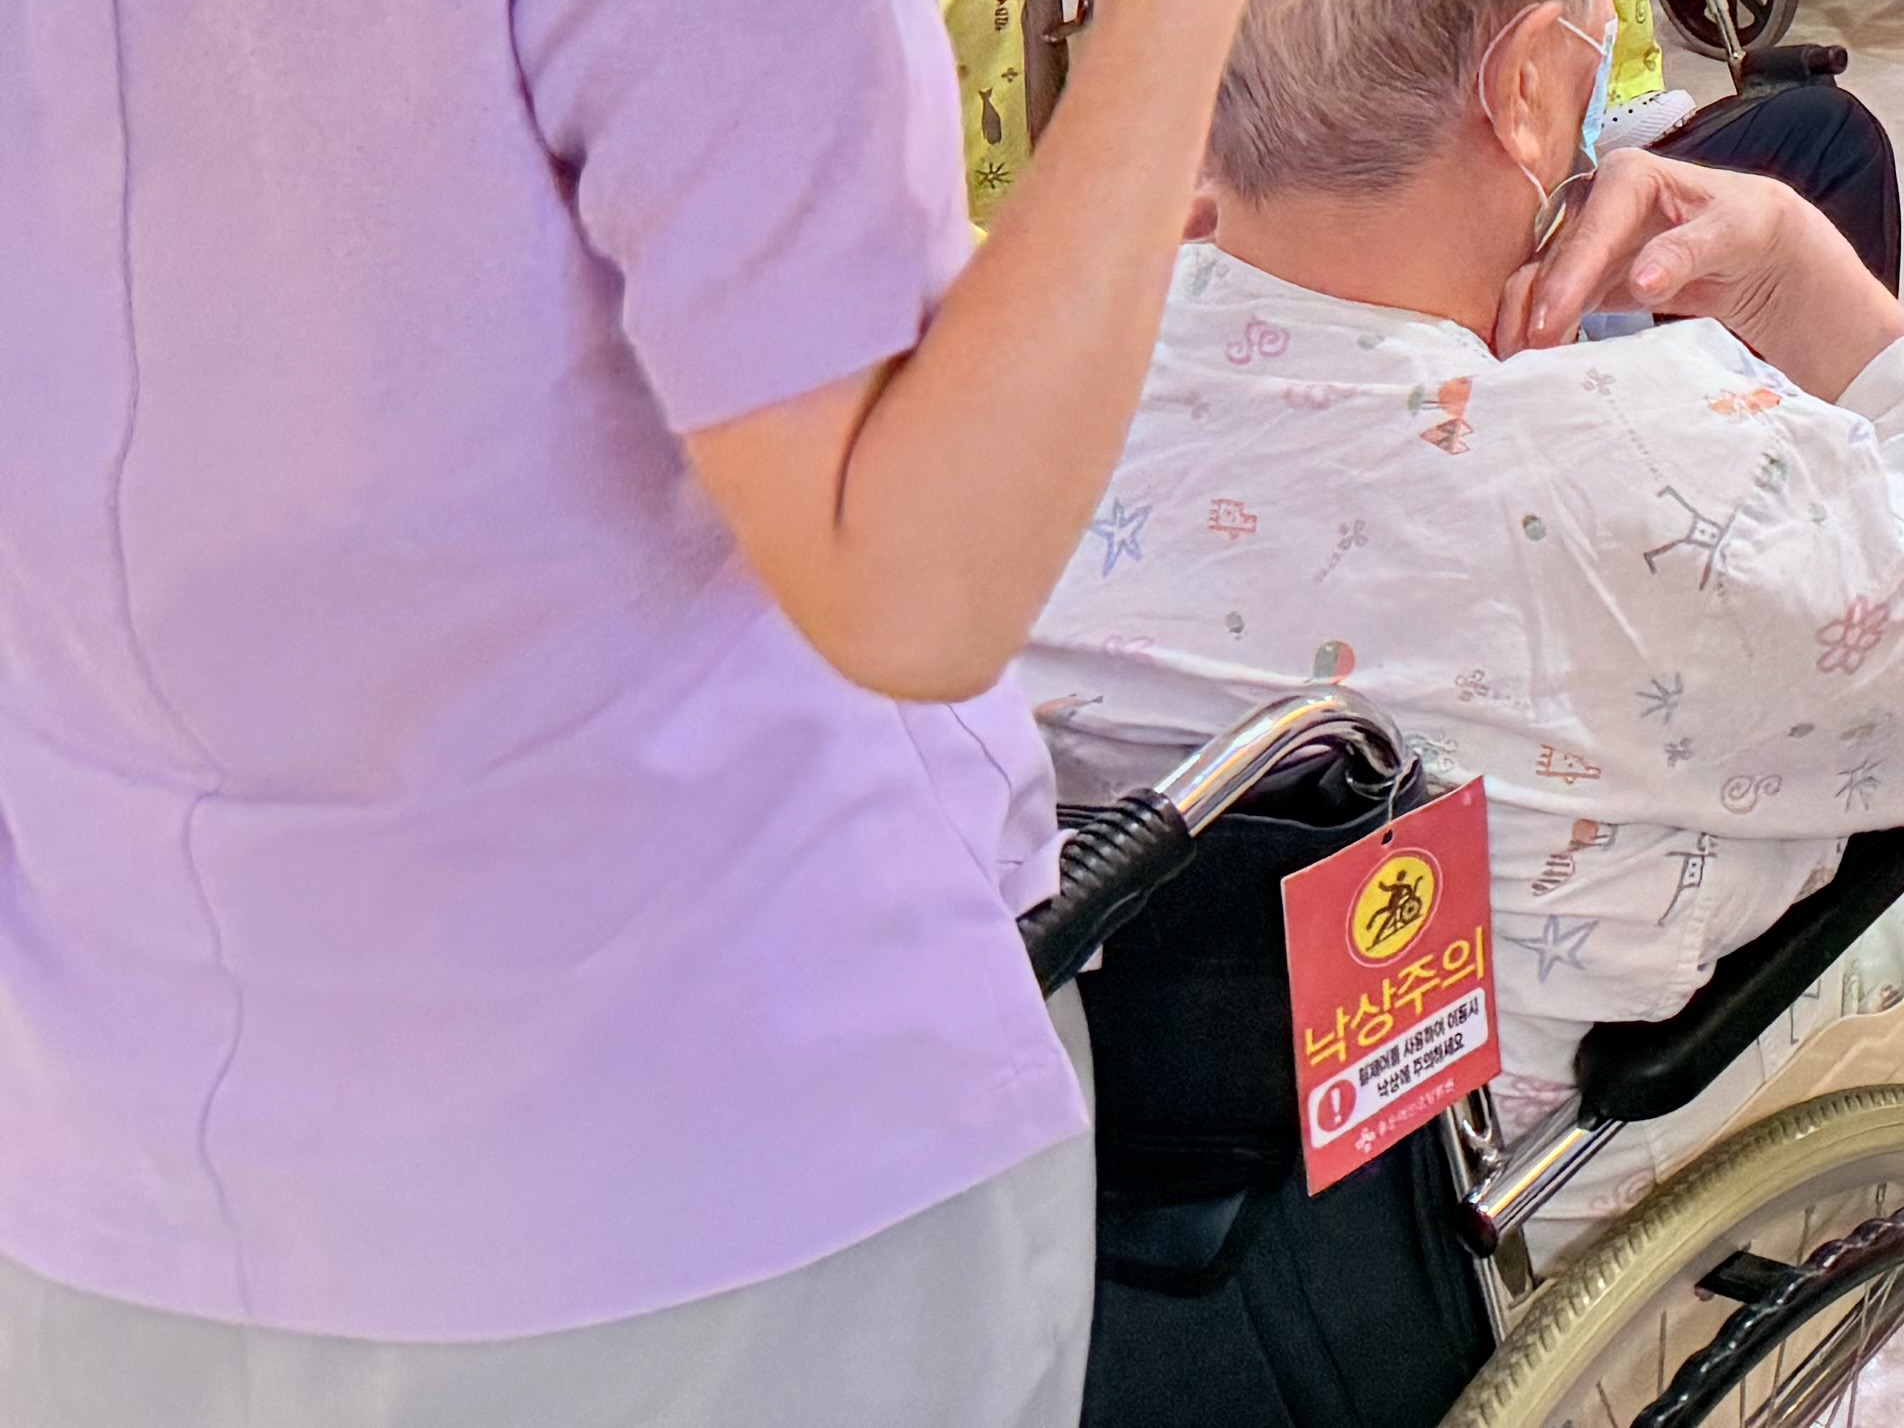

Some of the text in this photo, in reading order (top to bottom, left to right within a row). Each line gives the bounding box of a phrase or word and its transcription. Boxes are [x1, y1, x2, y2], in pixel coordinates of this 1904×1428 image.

[1305, 926, 1485, 1066] 낙상주의
[1402, 1019, 1446, 1065] 사용하여
[1446, 996, 1479, 1033] 이동시
[1376, 1031, 1465, 1098] 낙상에 주의하세요
